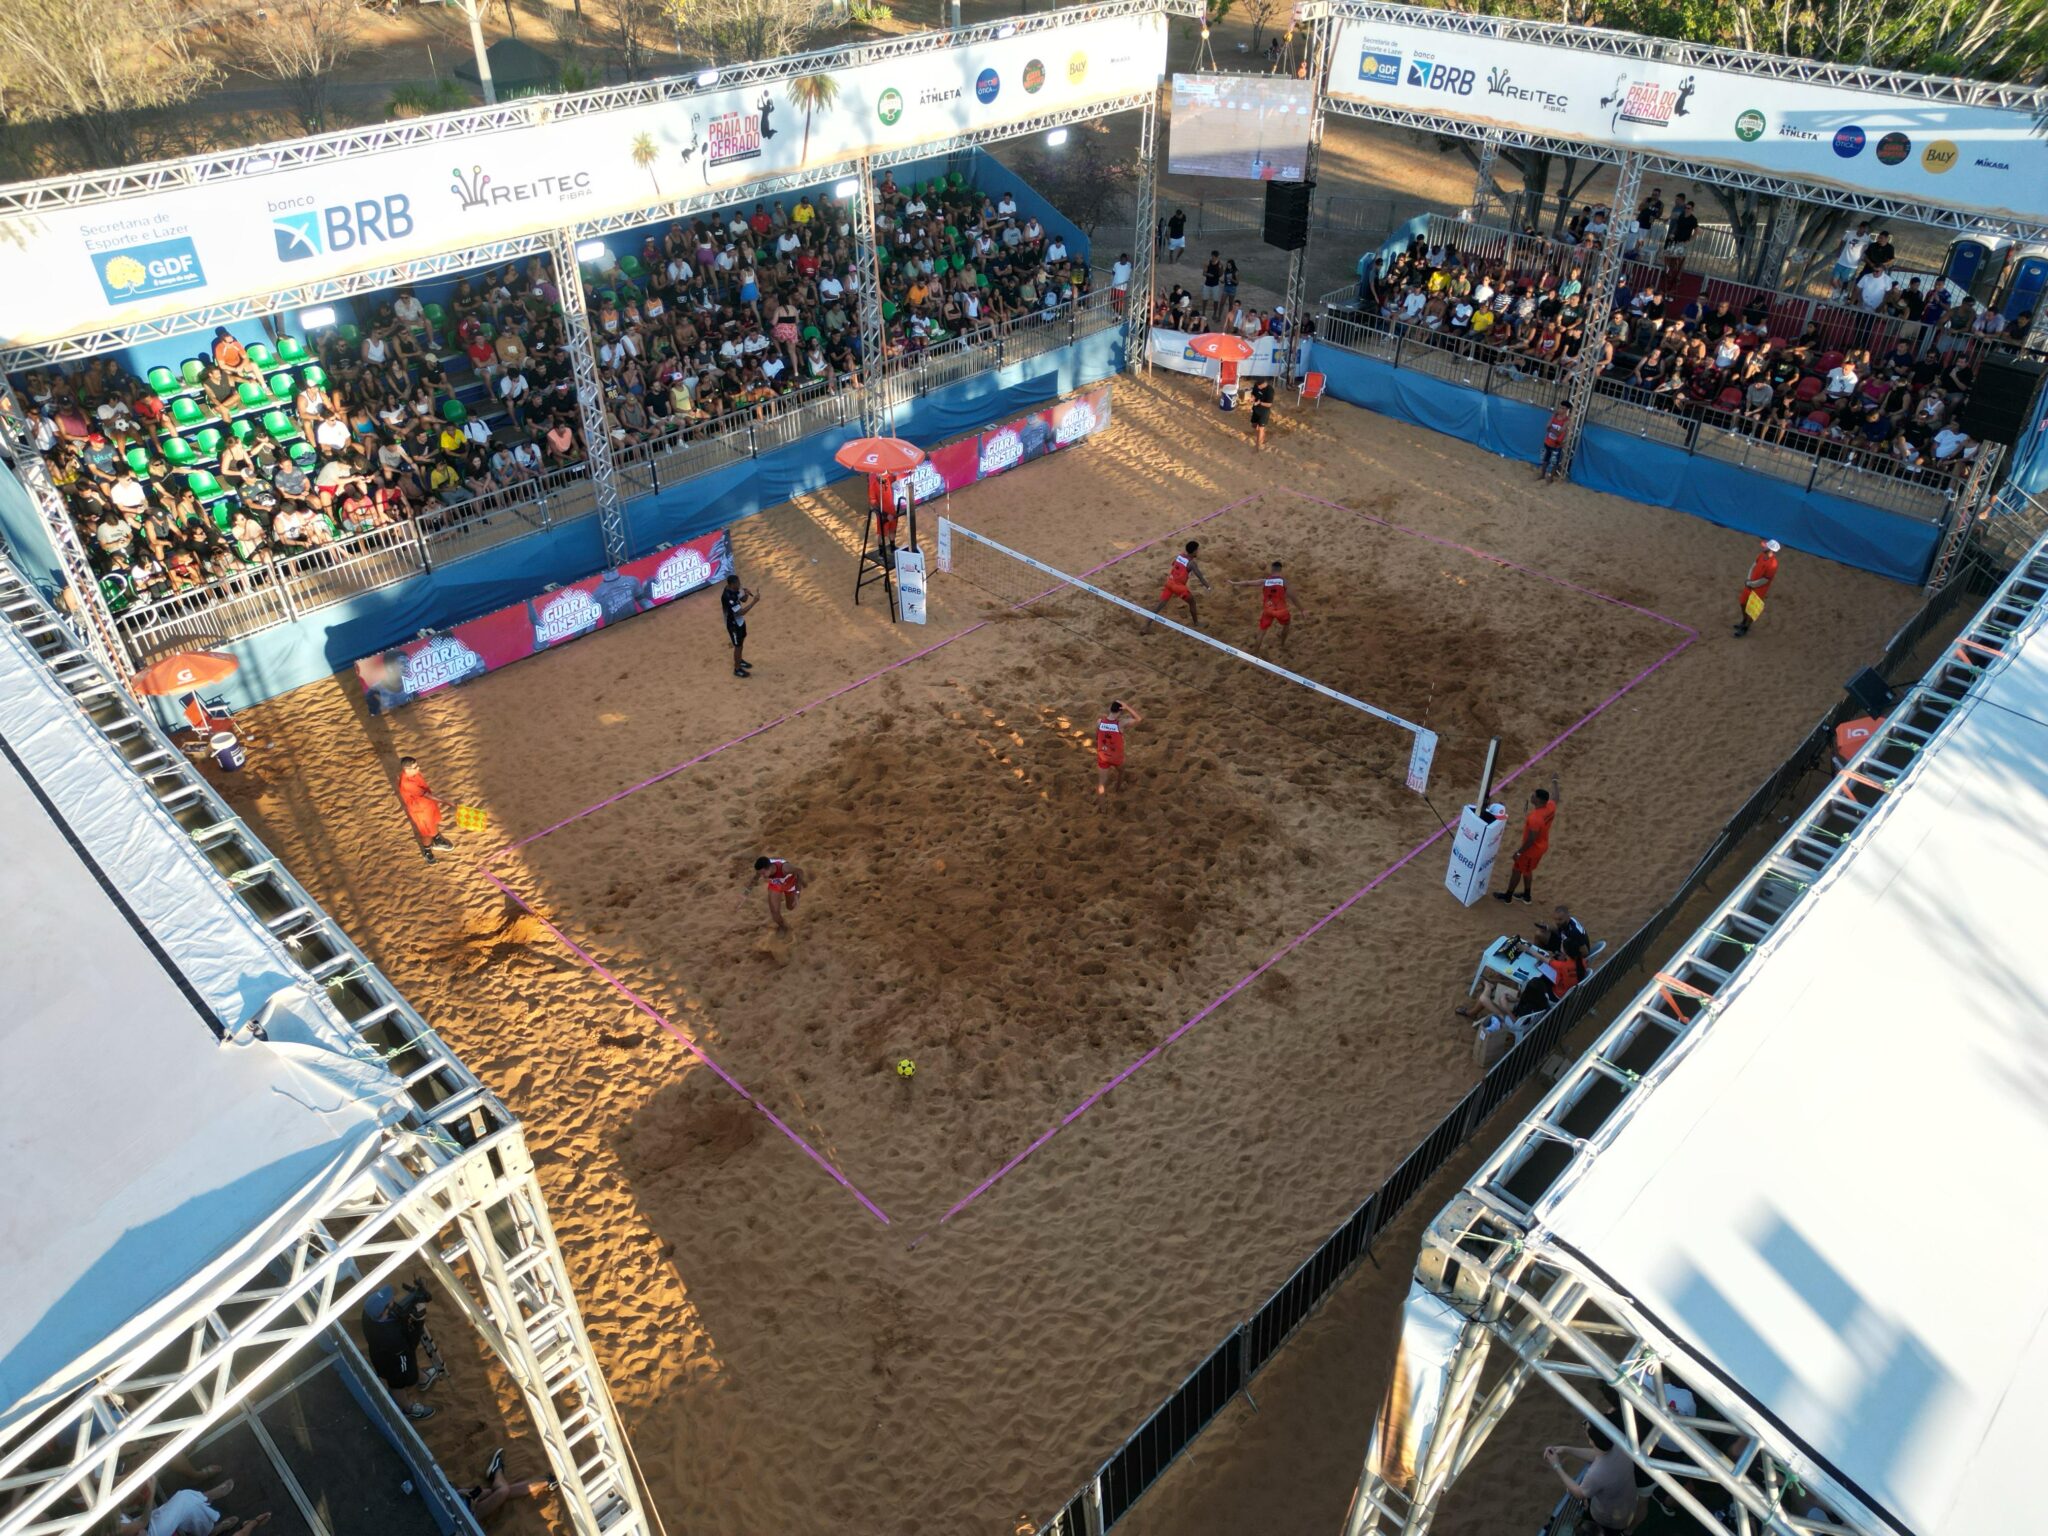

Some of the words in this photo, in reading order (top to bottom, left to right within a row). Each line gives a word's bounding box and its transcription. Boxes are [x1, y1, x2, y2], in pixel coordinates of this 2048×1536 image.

[1413, 50, 1435, 60] banco
[1378, 63, 1398, 75] GDF
[1430, 64, 1476, 96] BRB
[920, 88, 962, 105] ATHLETA
[1627, 86, 1659, 103] PRAIA
[1660, 91, 1676, 106] DO
[1543, 105, 1566, 113] FIBRA
[1623, 100, 1672, 120] CERRADO
[709, 118, 741, 141] PRAIA
[745, 114, 759, 134] DO
[1779, 128, 1818, 141] ATHLETA
[710, 132, 760, 159] CERRADO
[1926, 149, 1954, 164] BALY
[268, 195, 315, 213] banco
[559, 188, 592, 202] FIBRA
[80, 216, 150, 237] Secretaria
[153, 212, 170, 224] de
[324, 193, 414, 252] BRB
[85, 233, 138, 252] Esporte
[142, 230, 151, 240] e
[153, 223, 190, 239] Lazer
[148, 254, 193, 278] GDF
[1056, 416, 1096, 443] MONSTRO
[981, 443, 1023, 472] MONSTRO
[987, 435, 1016, 456] GUARA
[661, 555, 698, 580] GUARA
[653, 563, 711, 598] MONSTRO
[908, 586, 921, 595] BRB
[545, 596, 587, 623] GUARA
[538, 605, 600, 641] MONSTRO
[412, 643, 460, 673] GUARA
[177, 668, 193, 681] G
[404, 653, 474, 692] MONSTRO
[1458, 853, 1474, 870] BRB
